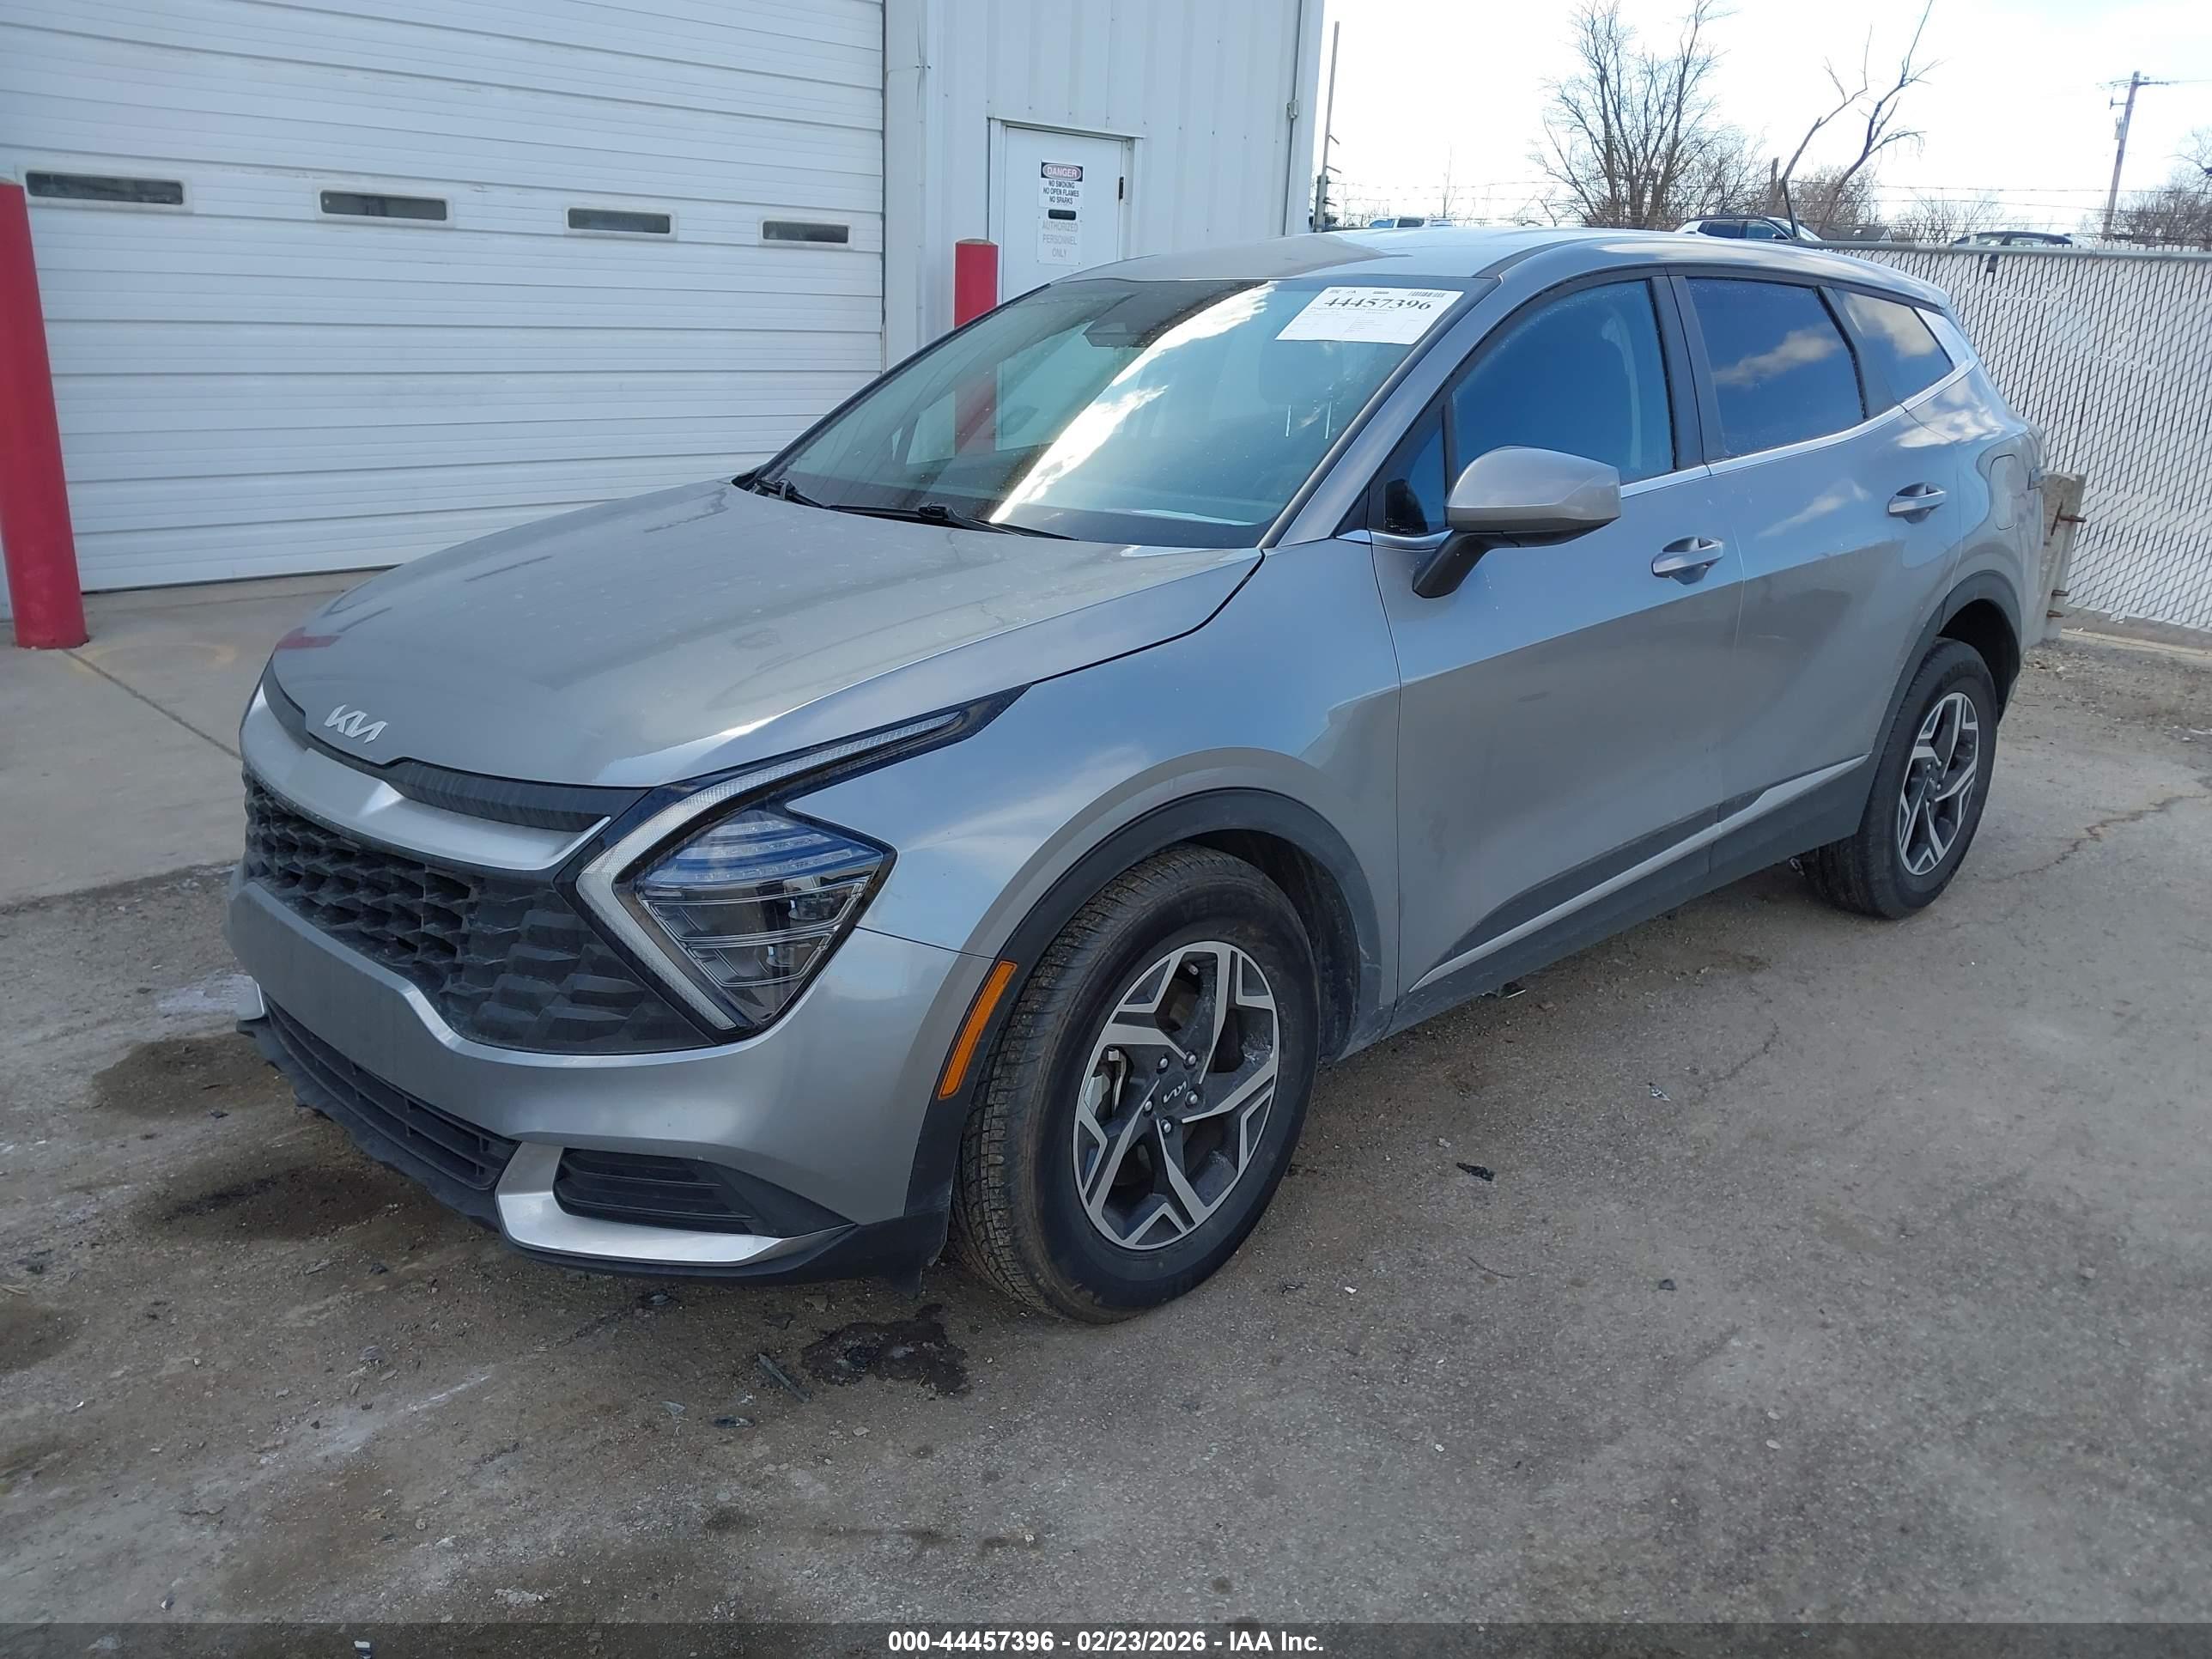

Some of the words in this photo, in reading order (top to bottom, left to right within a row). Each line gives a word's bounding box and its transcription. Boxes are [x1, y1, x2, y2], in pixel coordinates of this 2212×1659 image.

[1047, 166, 1078, 178] DANGER
[1055, 180, 1075, 189] SMOKING
[1063, 189, 1079, 198] FLAMES
[1042, 220, 1079, 232] AUTHORIZED
[1042, 234, 1078, 246] PERSONNEL
[1052, 247, 1067, 258] ONLY
[1324, 296, 1434, 311] 44457396
[324, 704, 388, 744] KIA
